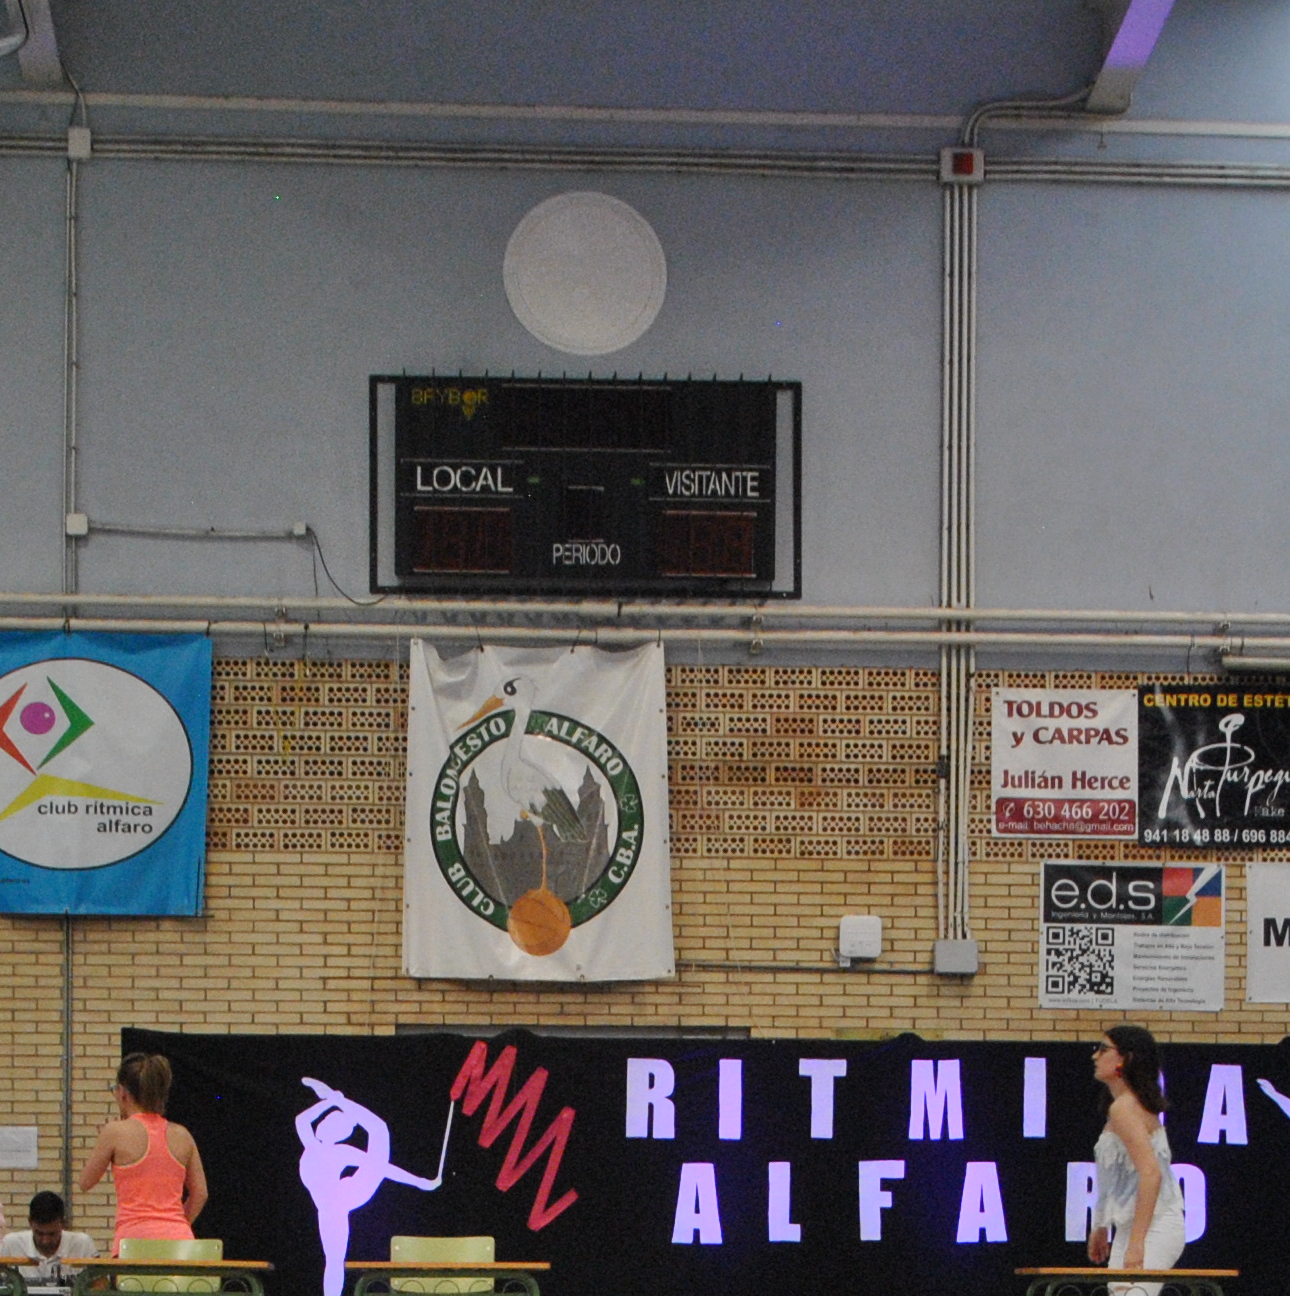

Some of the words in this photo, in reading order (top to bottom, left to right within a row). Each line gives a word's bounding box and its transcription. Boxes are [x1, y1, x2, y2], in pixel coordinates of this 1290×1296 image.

[415, 466, 514, 492] LOCAL
[665, 471, 760, 497] VISITANTE
[552, 543, 621, 566] PERIODO
[1003, 700, 1099, 719] TOLDOS
[1143, 693, 1212, 707] CENTRO
[1216, 694, 1239, 707] DE
[545, 717, 625, 776] ALFARO
[1011, 731, 1025, 749] y
[1032, 726, 1129, 746] CARPAS
[1001, 769, 1064, 790] Julián
[1071, 770, 1131, 790] Herce
[37, 800, 79, 815] club
[85, 800, 154, 817] rítmica
[1023, 801, 1055, 820] 630
[1060, 802, 1093, 820] 466
[1098, 802, 1130, 820] 202
[96, 819, 154, 834] alfaro
[1143, 828, 1169, 842] 941
[1173, 828, 1190, 842] 18
[1193, 829, 1211, 843] 48
[1214, 829, 1231, 843] 88
[1241, 829, 1266, 843] 696
[608, 824, 639, 885] C.B.A.
[448, 862, 496, 916] CLUB
[1050, 871, 1156, 911] e.d.s
[625, 1057, 1249, 1146] RITMIA
